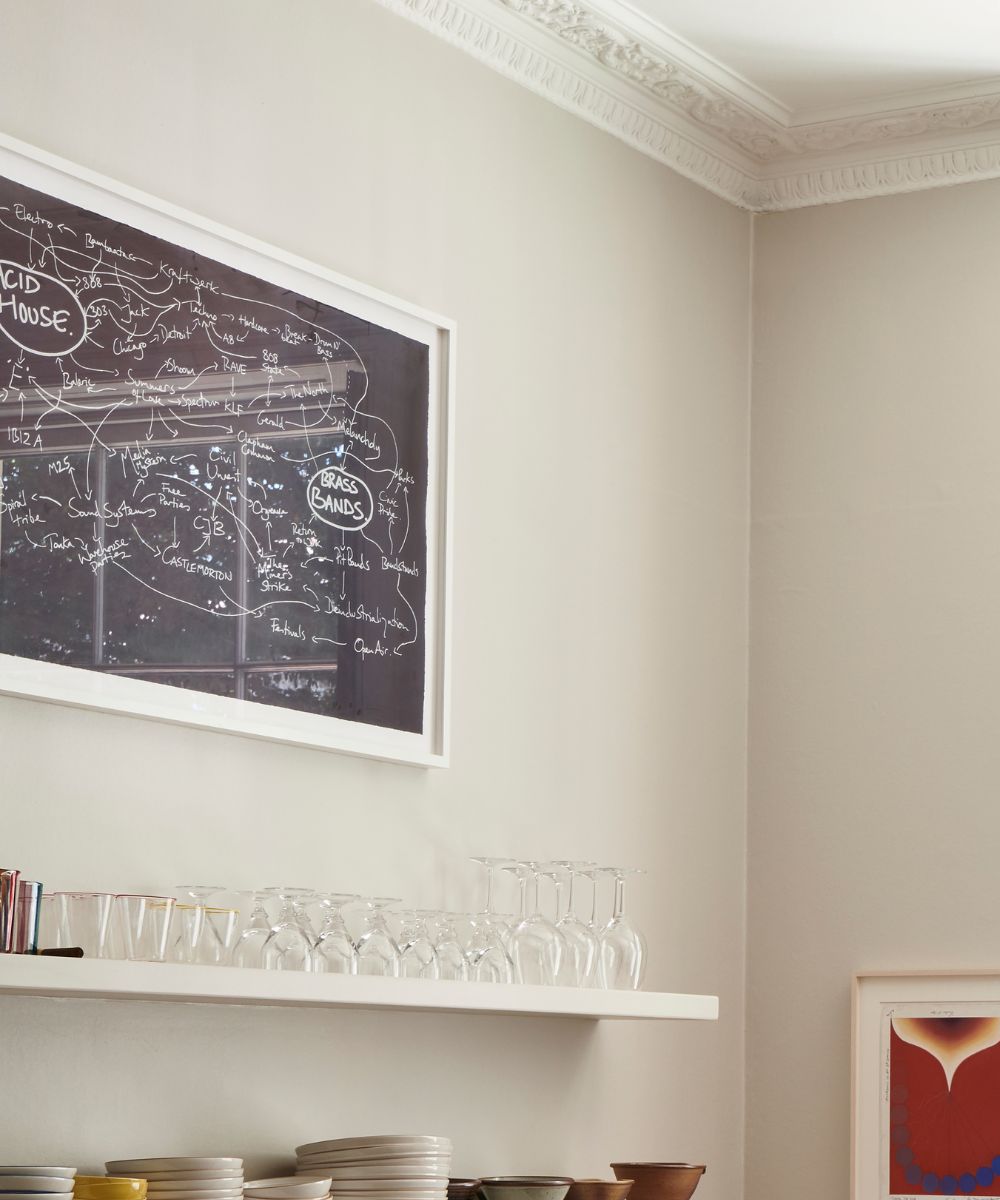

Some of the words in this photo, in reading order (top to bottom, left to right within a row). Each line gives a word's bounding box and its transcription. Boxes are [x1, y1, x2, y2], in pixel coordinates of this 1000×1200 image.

[13, 203, 54, 229] Electro
[82, 276, 103, 289] 808
[159, 259, 220, 295] Kraftwerk
[89, 304, 109, 316] 303
[119, 302, 151, 324] Jack
[182, 300, 218, 321] Techno
[158, 323, 192, 345] Detroit
[113, 337, 147, 361] Chicago
[262, 348, 279, 363] 808
[221, 354, 247, 375] RAVE
[302, 380, 329, 396] North
[224, 398, 244, 418] KLF
[256, 409, 286, 431] Gerald
[161, 482, 187, 498] Free
[320, 470, 359, 495] BRASS
[158, 492, 191, 512] Parties
[161, 545, 233, 581] CASTLEMORTON
[259, 579, 293, 592] Strike
[269, 617, 307, 642] Festivals
[353, 637, 375, 661] Open
